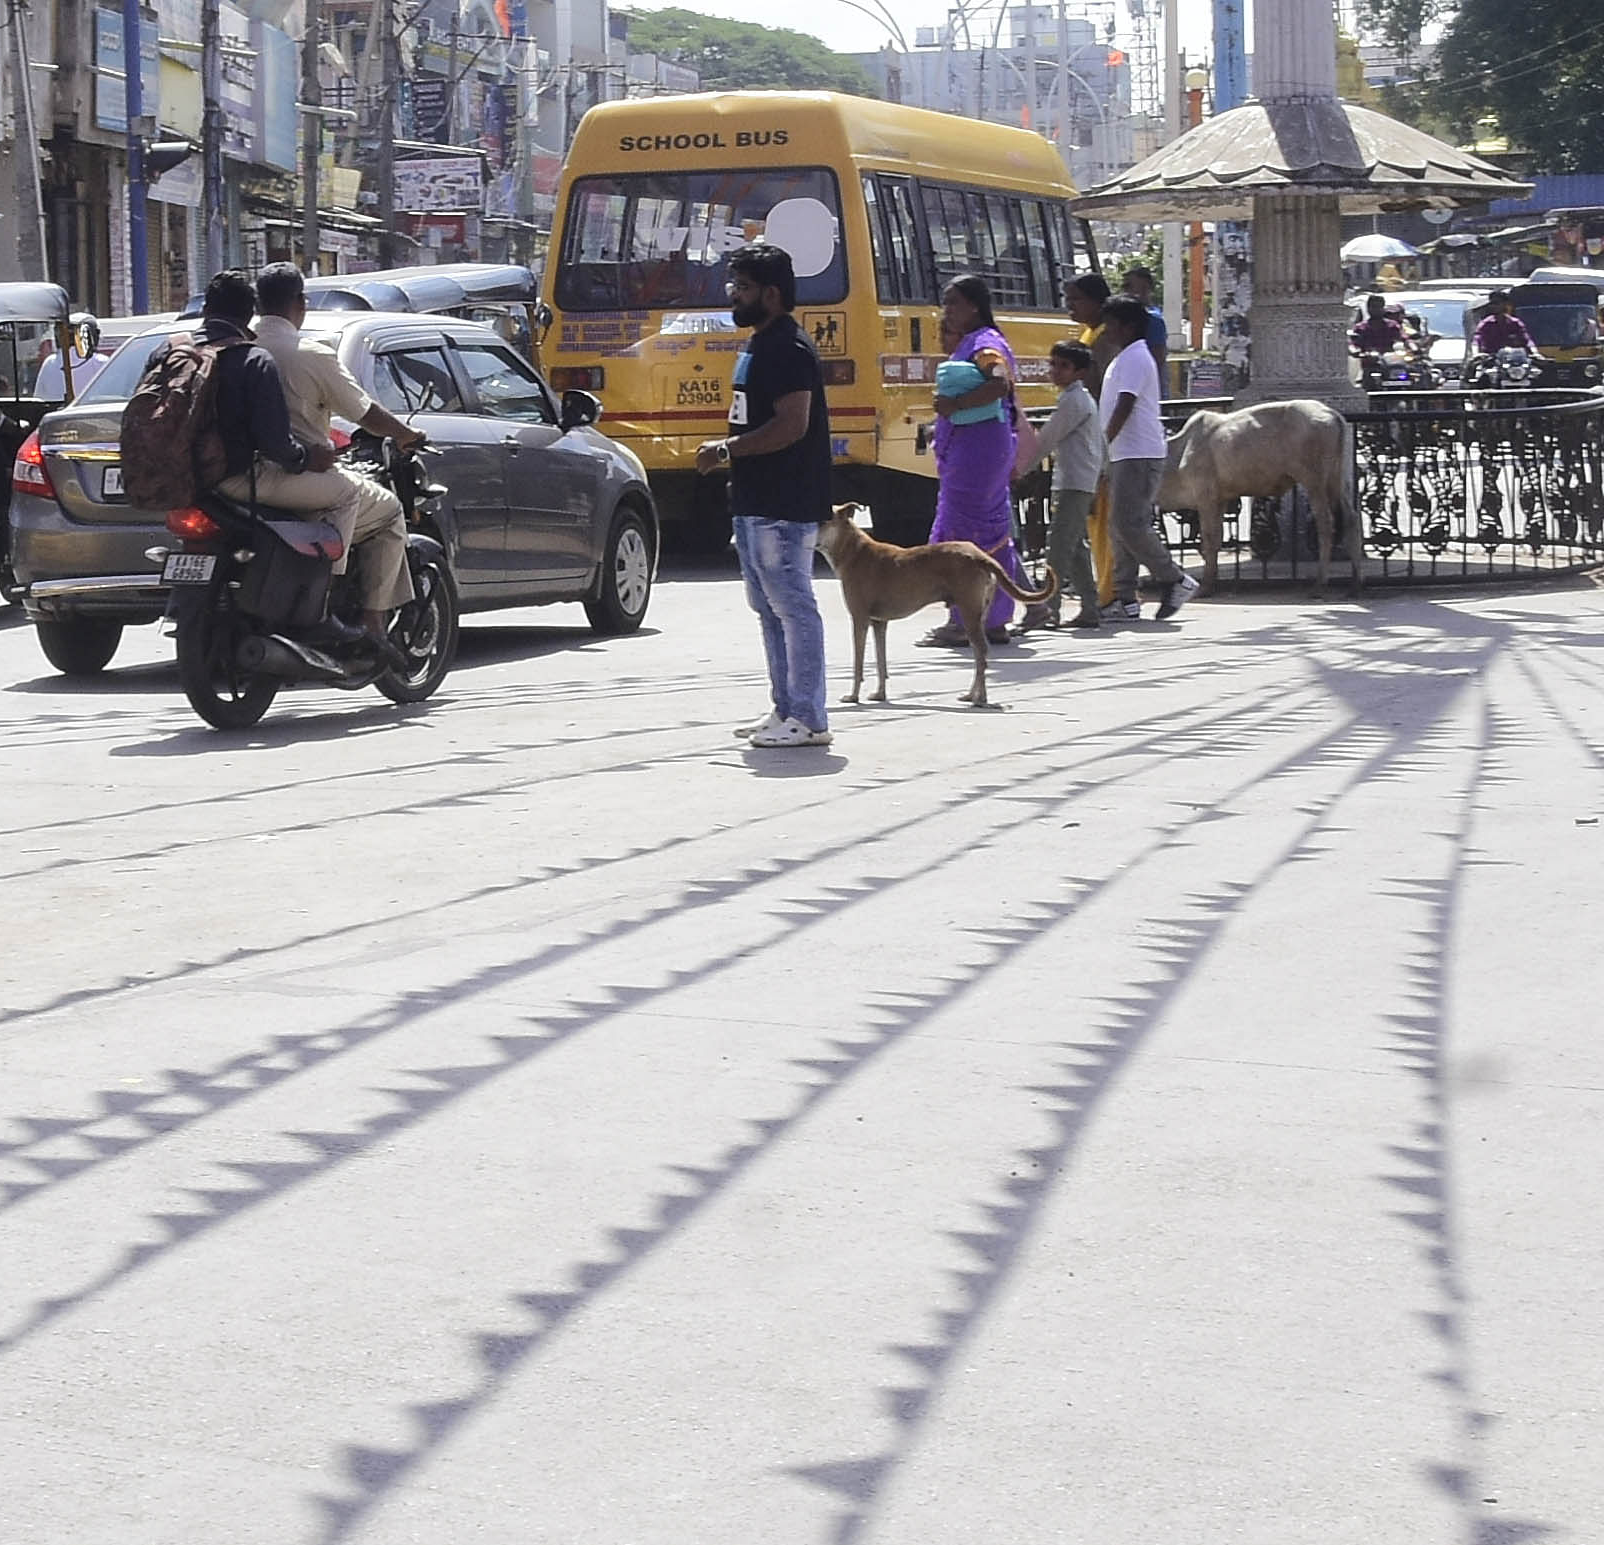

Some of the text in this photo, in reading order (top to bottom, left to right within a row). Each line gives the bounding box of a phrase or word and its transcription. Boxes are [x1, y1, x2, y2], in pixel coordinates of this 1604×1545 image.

[619, 129, 789, 152] SCHOOL BUS
[679, 380, 720, 393] KA16
[677, 393, 722, 405] D3904
